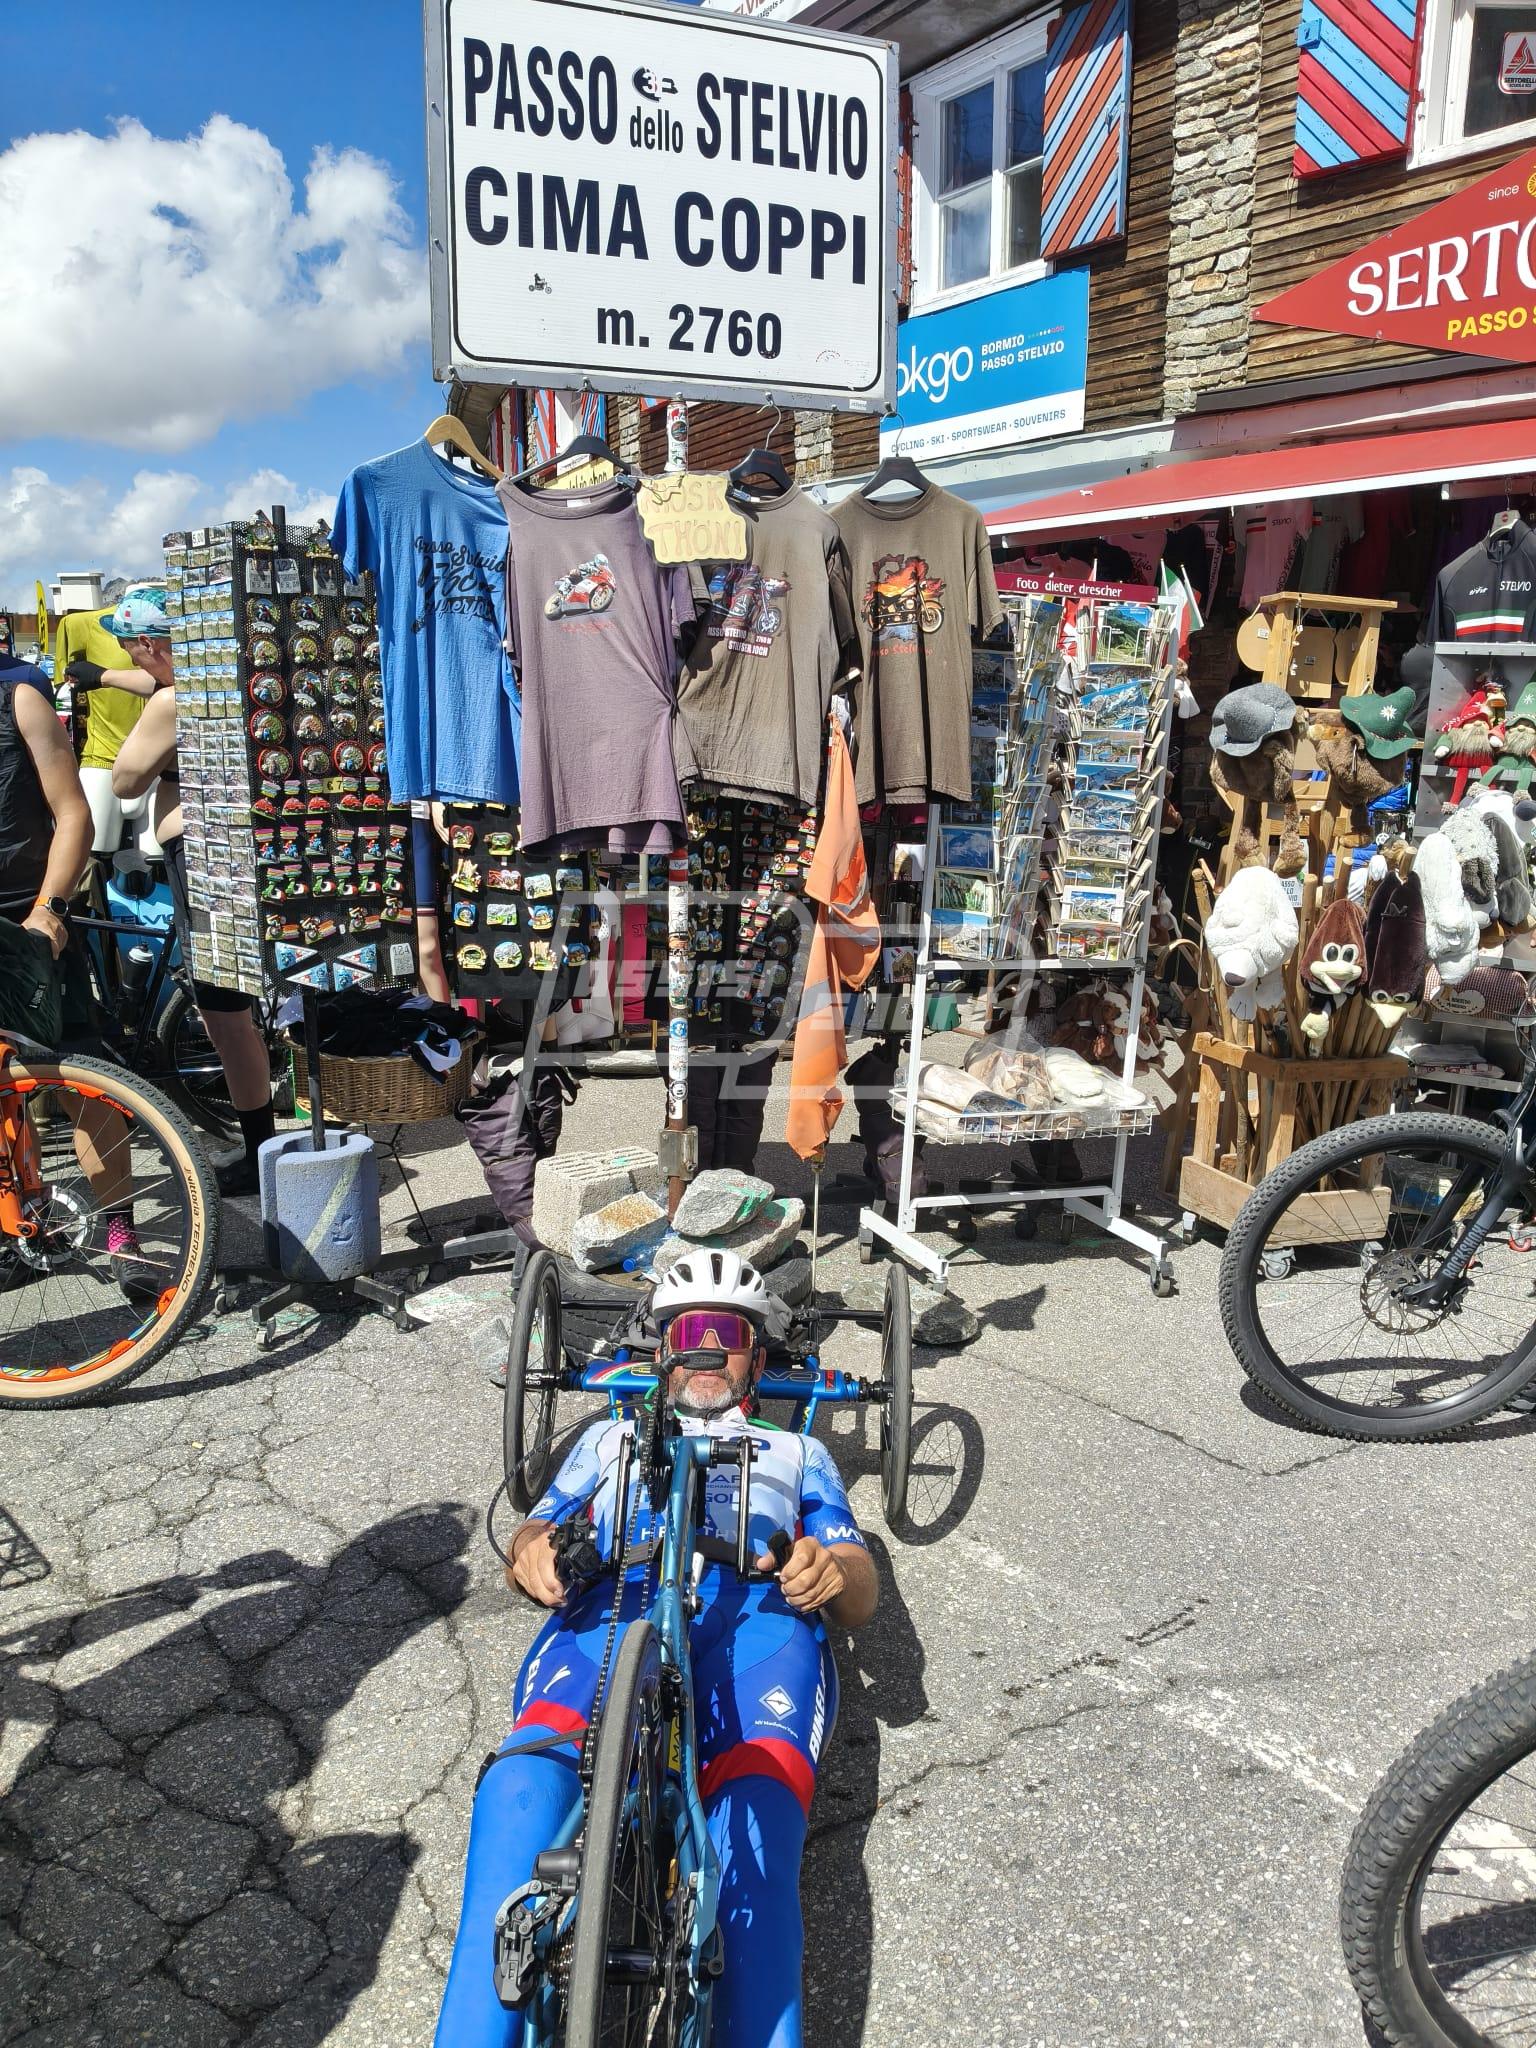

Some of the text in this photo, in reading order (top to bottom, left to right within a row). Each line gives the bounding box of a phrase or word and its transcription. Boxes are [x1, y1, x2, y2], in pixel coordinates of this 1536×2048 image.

[464, 38, 867, 180] PASSO dello STELVIO
[1488, 184, 1520, 200] since
[465, 166, 866, 284] CIMA COPPI
[597, 304, 781, 359] m. 2760
[1448, 306, 1527, 341] PASSO
[982, 334, 1025, 356] BORMIO
[982, 340, 1064, 372] PASSO STELVIO
[891, 409, 1066, 453] CYCLING SKI SPORTSWEAR SOUVENIRS
[1016, 578, 1122, 597] foto dieter drescher
[1500, 581, 1532, 592] STELVIO
[100, 1095, 134, 1118] URSUS
[181, 1174, 201, 1293] vittoria TERRENO
[1442, 1224, 1487, 1279] ROCKSHOX
